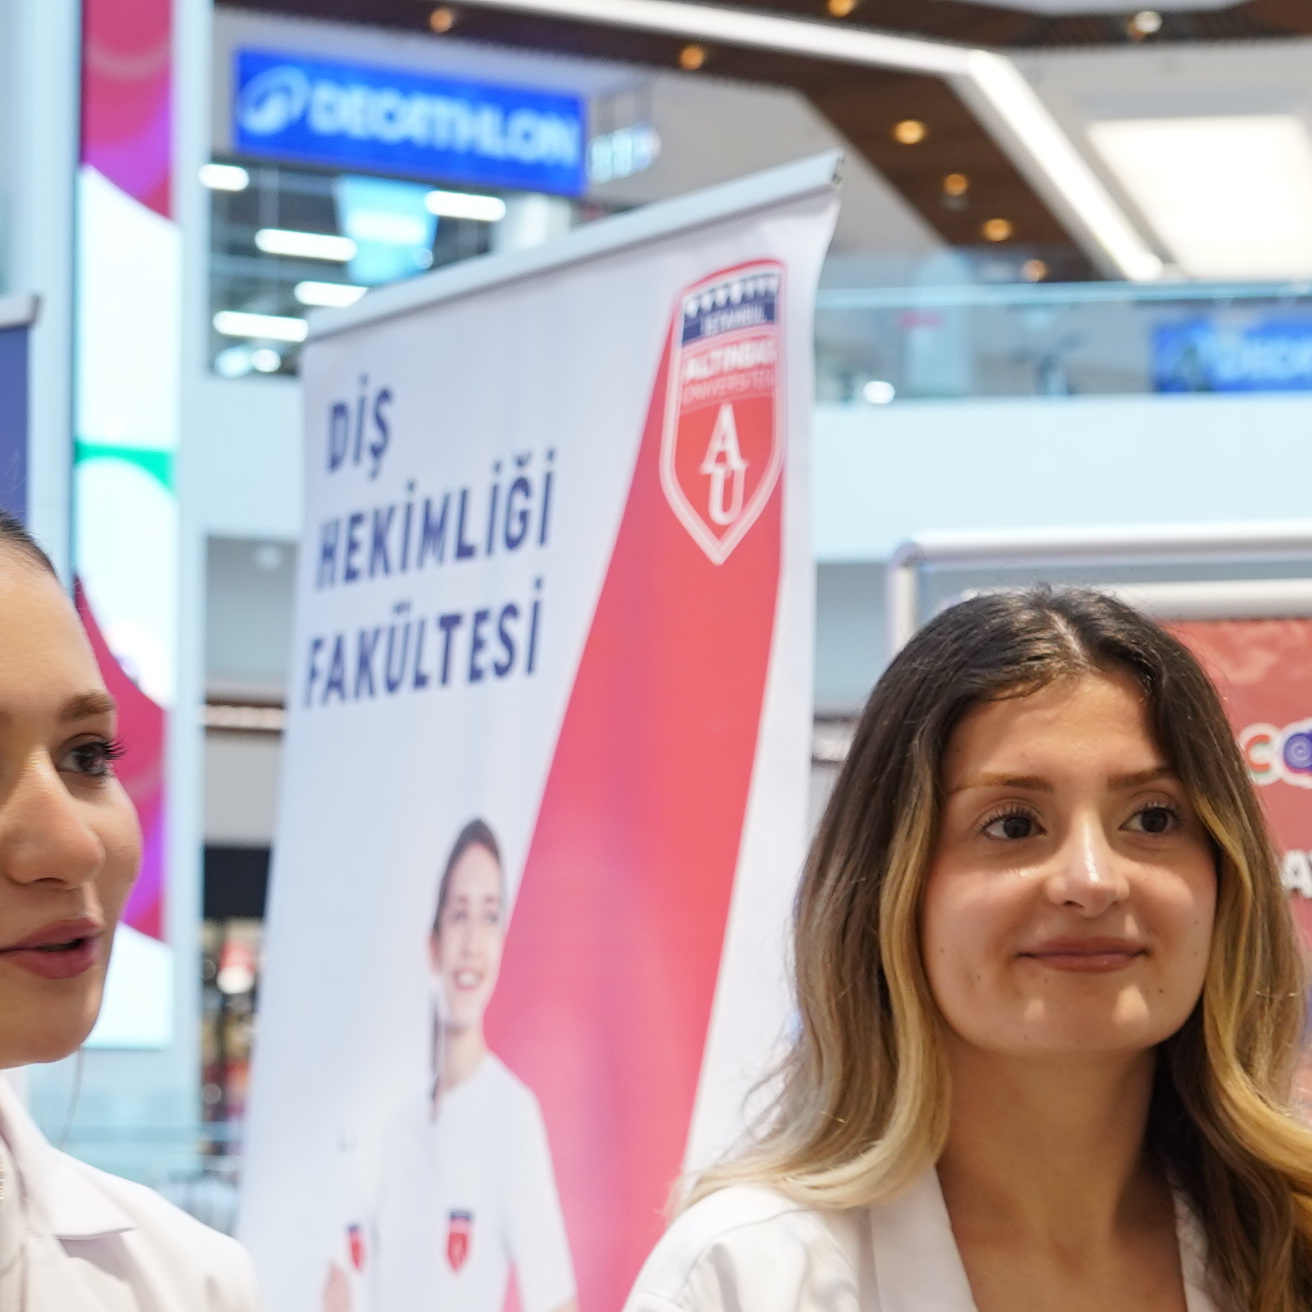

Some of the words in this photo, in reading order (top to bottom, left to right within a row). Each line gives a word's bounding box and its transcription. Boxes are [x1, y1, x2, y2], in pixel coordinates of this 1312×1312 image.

[306, 78, 582, 169] DECATHLON
[327, 372, 394, 481] DİŞ
[315, 448, 556, 592] HEKİMLİĞİ
[302, 576, 544, 709] FAKÜLTESİ
